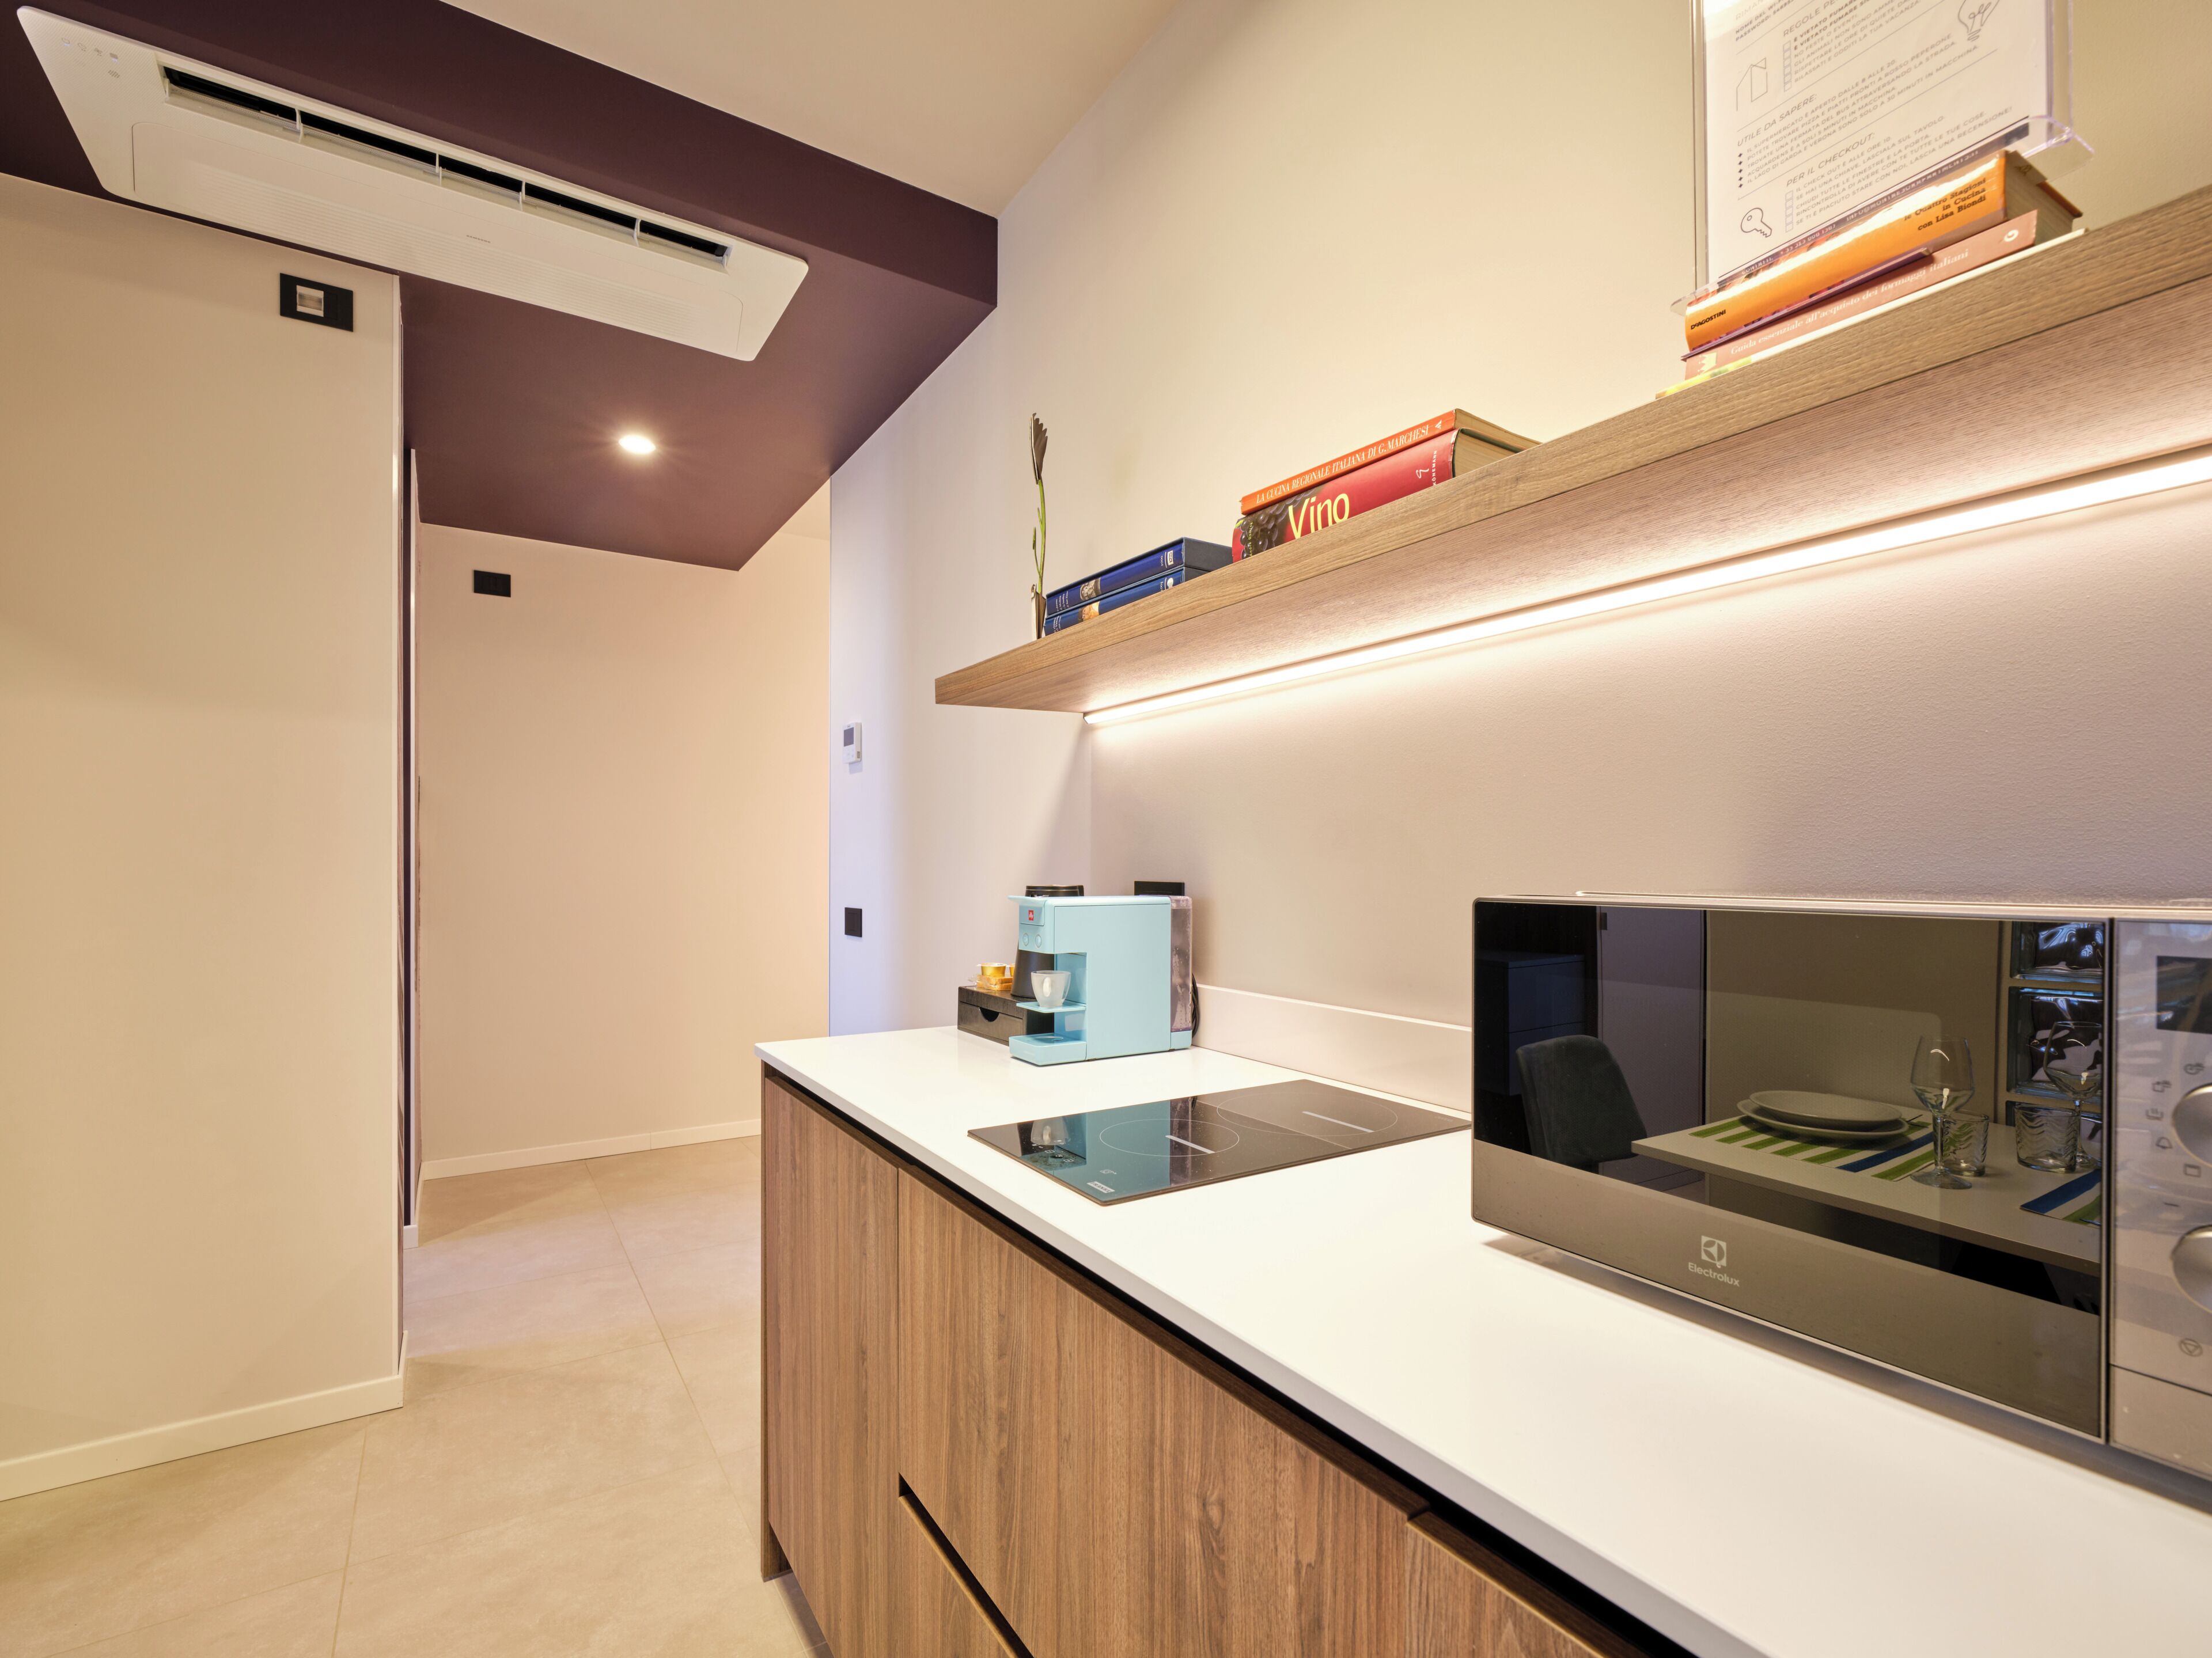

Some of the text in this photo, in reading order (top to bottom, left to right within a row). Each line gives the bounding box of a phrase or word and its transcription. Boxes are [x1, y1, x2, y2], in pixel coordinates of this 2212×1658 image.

[1736, 20, 1752, 34] NOME
[1755, 11, 1766, 21] DEL
[1783, 7, 1820, 37] REGOLE
[1794, 13, 1872, 67] GLI ANIMALI NON SONO
[1794, 6, 1895, 75] RISPETTARE LE ORE DI QUIETE
[1794, 50, 1804, 59] NO
[1805, 36, 1824, 51] FESTE
[1800, 25, 1828, 46] VIETATO
[1830, 5, 1857, 26] FUMARE
[1800, 17, 1827, 37] VIETATO
[1794, 60, 1826, 83] RILASSATI
[1834, 40, 1857, 58] GODITI
[1859, 33, 1868, 41] LA
[1870, 23, 1883, 34] TUA
[1737, 94, 1816, 146] UTILE DA SAPERE:
[1747, 145, 1769, 161] POTETE
[1771, 127, 1798, 146] TROVARE
[1801, 115, 1820, 128] PIZZA
[1827, 97, 1848, 112] PIATTI
[1850, 81, 1875, 98] PRONTI
[1884, 60, 1909, 78] ROSSO
[1911, 33, 1951, 62] PEPERONE.
[1748, 41, 1956, 168] TROVATE UNA FERMATA DEL BUS ATTRAVERSANDO LA STRADA.
[1754, 116, 1803, 149] SUPERMERCATO
[1811, 96, 1836, 114] APERTO
[1838, 81, 1859, 98] DALLE
[1868, 66, 1884, 79] ALLE
[1887, 59, 1896, 68] 20.
[1755, 168, 1770, 180] LAGO
[1780, 150, 1802, 164] GARDA
[1809, 130, 1836, 147] VERONA
[1838, 117, 1858, 131] SONO
[1859, 104, 1878, 119] SOLO
[1887, 94, 1895, 102] 30
[1897, 77, 1923, 96] MINUTI
[1936, 45, 1978, 73] MACCHINA.
[1747, 150, 1789, 177] ACQUARDENS
[1802, 134, 1816, 145] SOLI
[1823, 115, 1847, 132] MINUTI
[1858, 86, 1896, 111] MACCHINA.
[1805, 186, 1816, 195] HAI
[1819, 178, 1832, 188] UNA
[1834, 163, 1861, 180] CHIAVE,
[1863, 143, 1896, 164] LASCIALA
[1898, 134, 1911, 144] SUL
[1914, 116, 1945, 135] TAVOLO.
[1786, 132, 1874, 187] PER IL CHECKOUT:
[1796, 187, 1846, 217] RINCONTROLLA
[1857, 169, 1879, 184] AVERE
[1881, 160, 1897, 170] CON
[1910, 140, 1932, 155] TUTTE
[1934, 134, 1943, 142] LE
[1946, 124, 1960, 135] TUE
[1963, 111, 1984, 126] COSE.
[1796, 194, 1819, 209] CHIUDI
[1820, 183, 1840, 196] TUTTE
[1853, 158, 1884, 179] FINESTRE
[1893, 149, 1902, 157] LA
[1904, 134, 1930, 150] PORTA.
[1803, 174, 1825, 188] CHECK
[1827, 165, 1840, 175] OUT
[1849, 151, 1864, 163] ALLE
[1867, 142, 1881, 153] ORE
[1819, 194, 1850, 213] PIACIUTO
[1852, 181, 1873, 196] STARE
[1875, 172, 1891, 183] CON
[1893, 164, 1908, 173] NOI,
[1910, 147, 1936, 164] LASCIA
[1938, 138, 1955, 149] UNA
[1957, 107, 2012, 139] RECENSIONE!
[1915, 198, 1948, 215] Quattro
[1950, 178, 1986, 199] Stagioni
[1918, 194, 1986, 230] con Lisa Biondi
[1954, 188, 1986, 205] Cucina
[1730, 340, 1756, 355] Guida
[1758, 318, 1803, 342] essenziale
[1862, 288, 1878, 303] dei
[1881, 270, 1926, 293] formaggi
[1929, 249, 1968, 272] italiani
[1256, 494, 1264, 504] LA
[1266, 484, 1289, 499] CUCINA
[1291, 465, 1330, 489] REGIONALE
[1332, 451, 1365, 475] ITALIANA
[1368, 446, 1376, 458] DI
[1288, 493, 1350, 539] Vino
[1688, 1262, 1740, 1287] Electrolux
